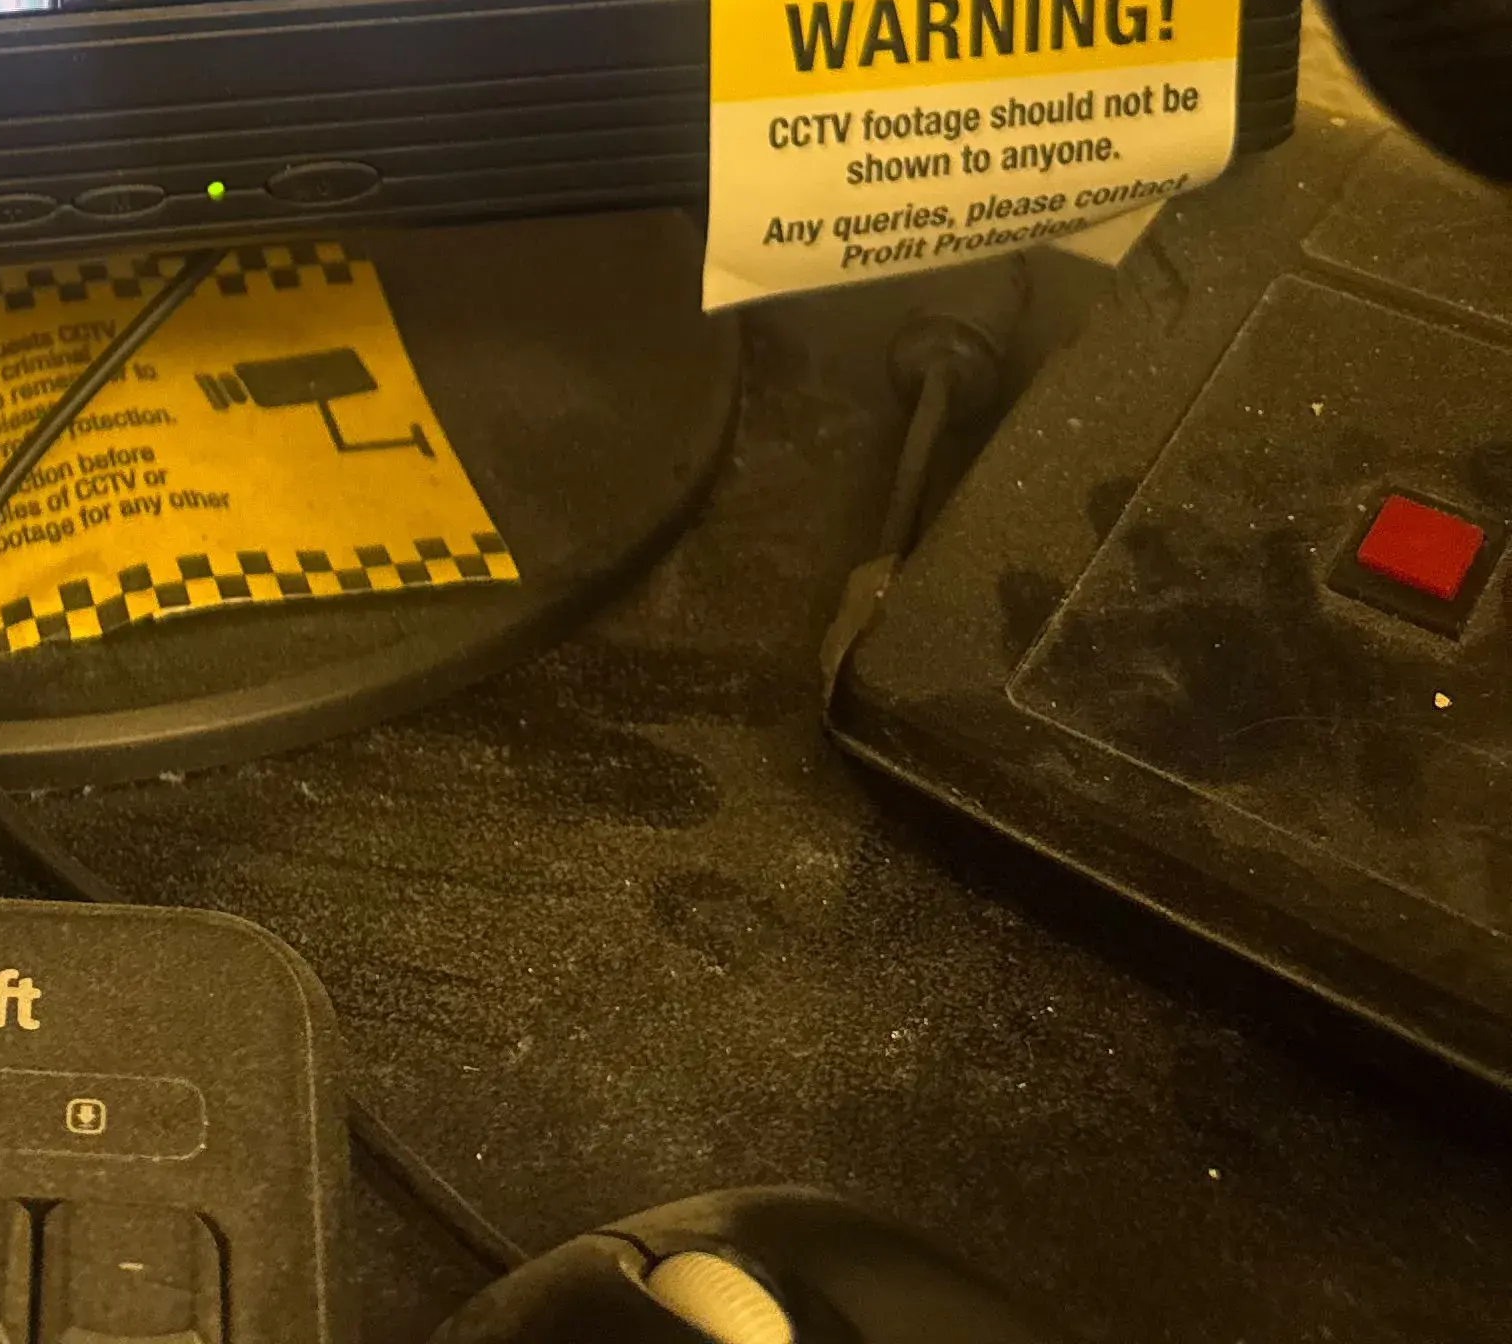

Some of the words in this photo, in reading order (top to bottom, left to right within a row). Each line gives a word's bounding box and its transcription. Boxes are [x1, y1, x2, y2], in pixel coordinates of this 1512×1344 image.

[768, 113, 851, 151] CCTV
[862, 107, 981, 144] footage
[989, 90, 1094, 130] should
[1104, 85, 1154, 119] not
[1162, 82, 1200, 113] be
[846, 146, 951, 186] shown
[961, 144, 990, 175] to
[1001, 137, 1121, 175] anyone.
[763, 214, 824, 247] Any
[832, 199, 955, 243] queries,
[964, 194, 1067, 227] please
[1073, 172, 1190, 208] contact
[841, 231, 926, 270] Profit
[59, 319, 117, 344] CCTV
[1, 344, 92, 382] criminal
[134, 364, 158, 382] to
[78, 445, 155, 474] before
[47, 484, 69, 512] of
[74, 467, 136, 500] CCTV
[143, 468, 170, 487] or
[79, 502, 112, 529] for
[118, 492, 162, 517] any
[168, 488, 231, 510] other
